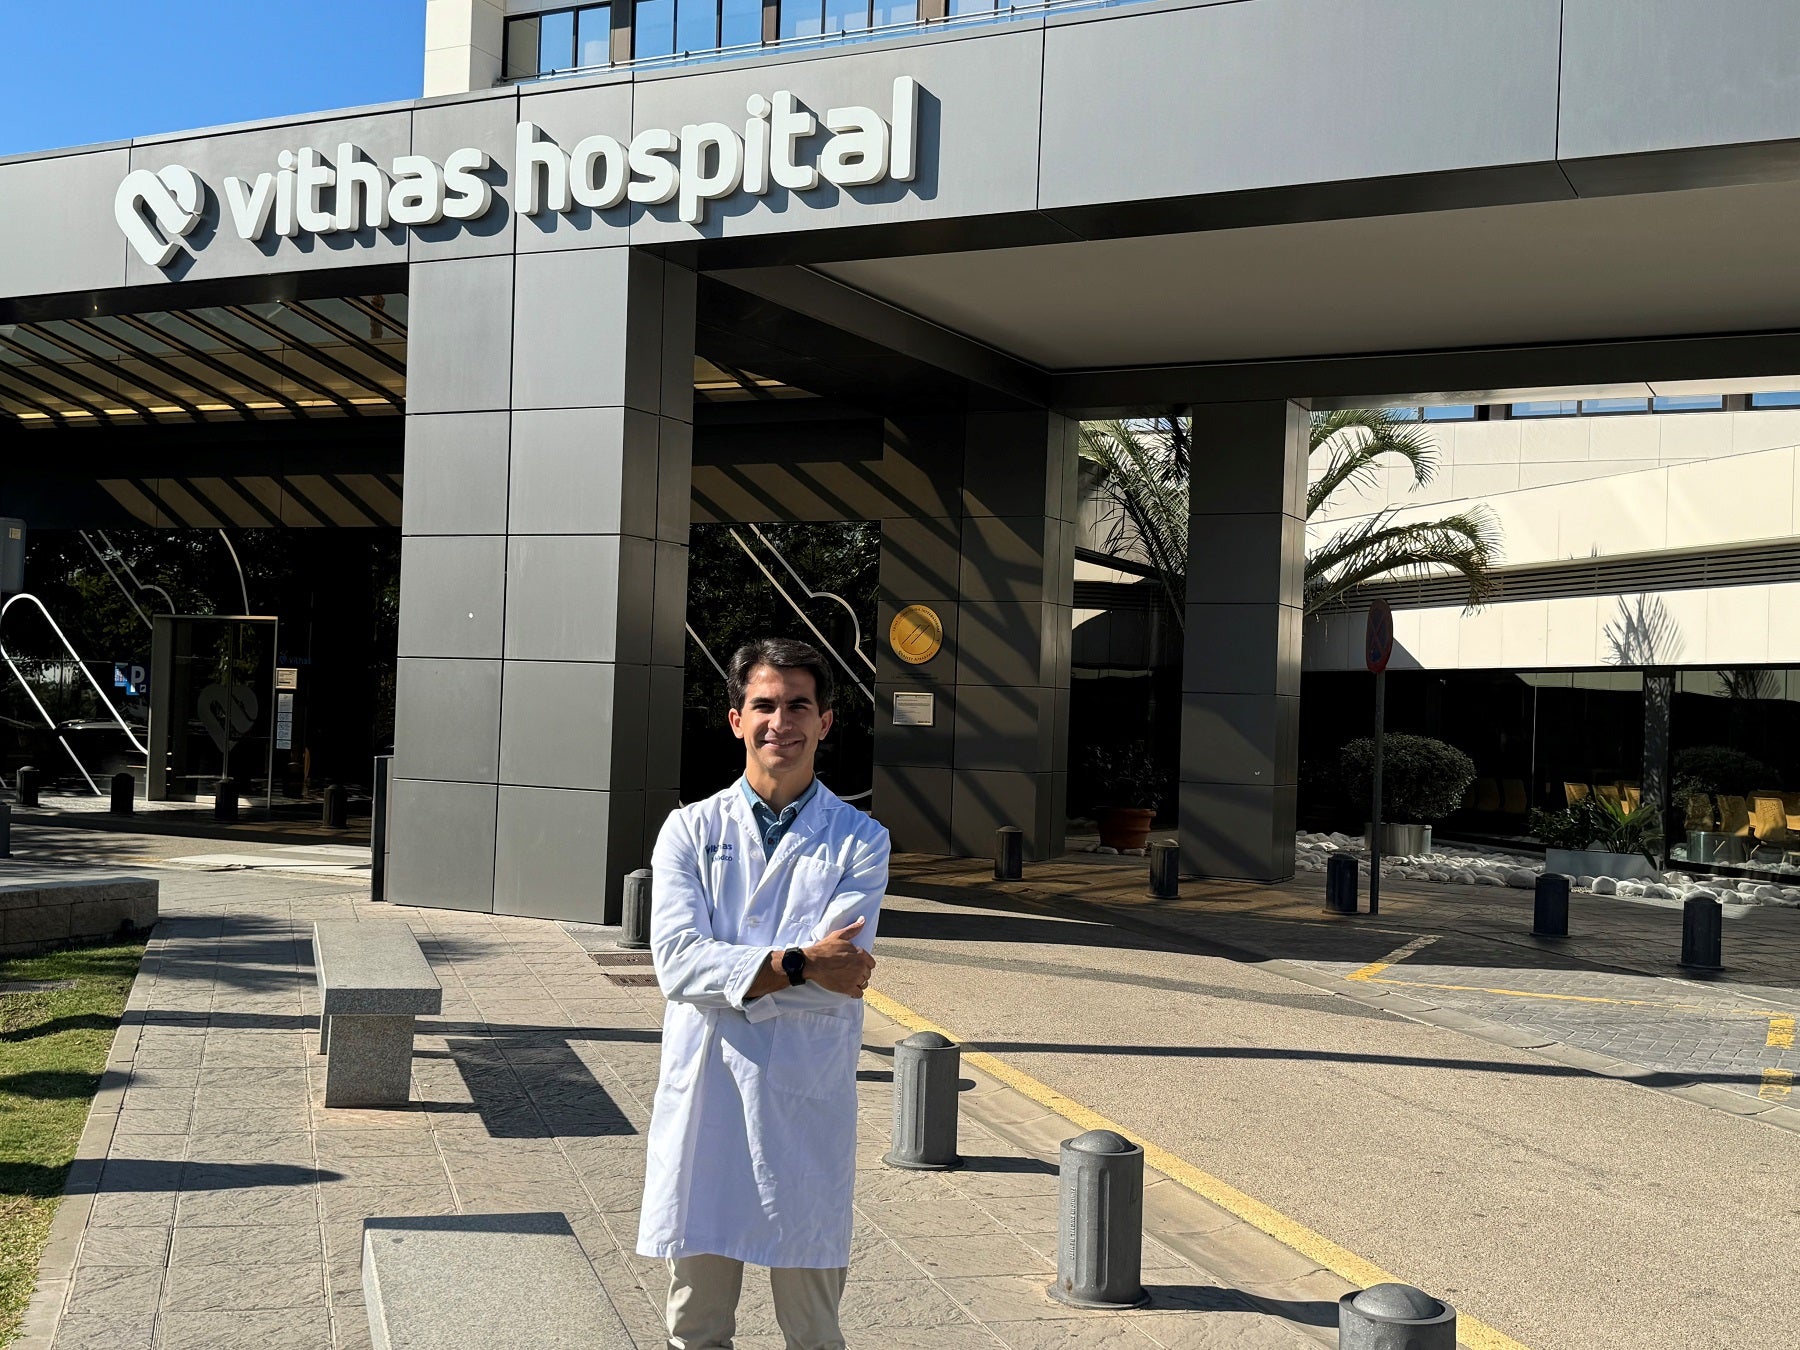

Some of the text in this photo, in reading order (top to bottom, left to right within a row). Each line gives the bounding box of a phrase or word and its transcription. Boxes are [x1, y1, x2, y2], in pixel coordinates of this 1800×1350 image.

[223, 75, 919, 241] vithas hospital
[130, 665, 145, 693] P
